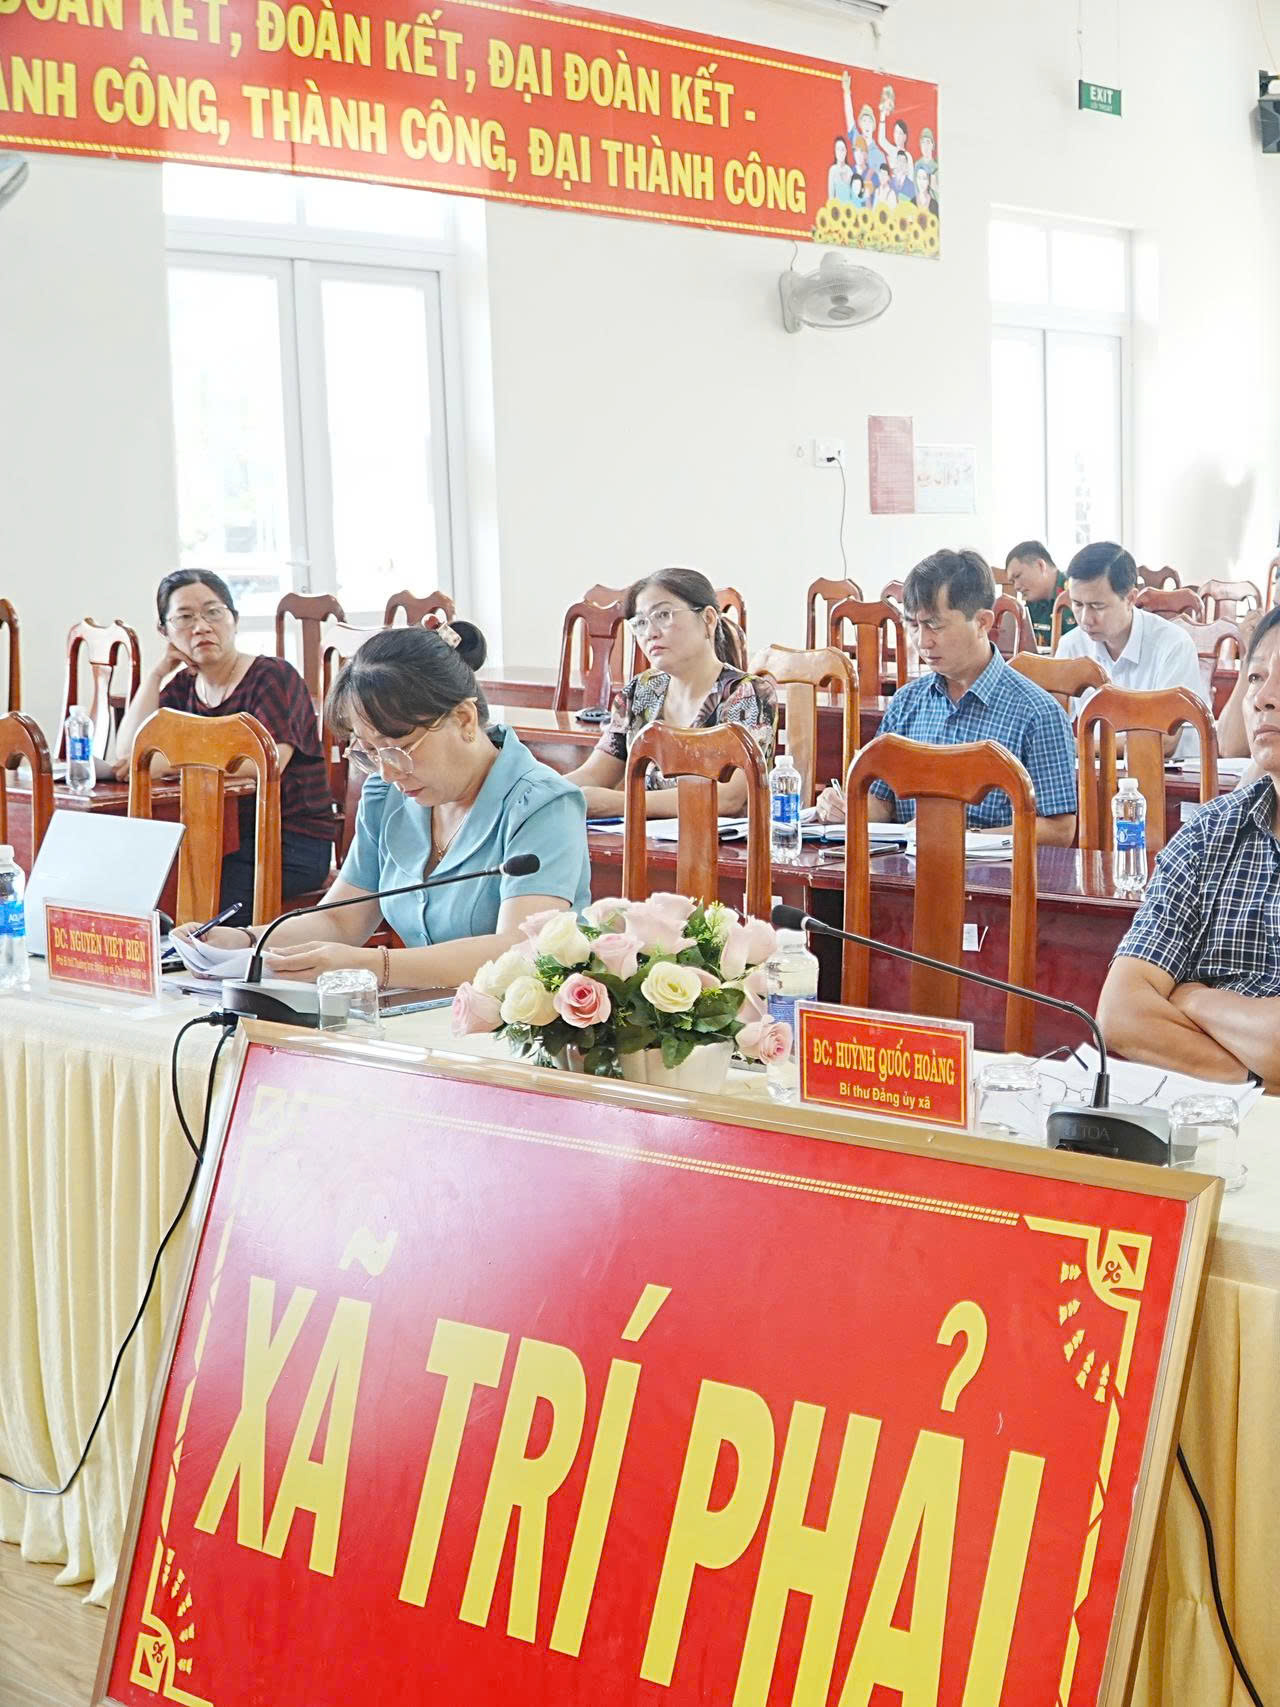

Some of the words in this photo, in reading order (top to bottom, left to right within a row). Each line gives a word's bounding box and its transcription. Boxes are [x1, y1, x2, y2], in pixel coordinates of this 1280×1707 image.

[256, 0, 371, 67] ĐOÀN
[385, 10, 476, 93] KẾT,
[488, 39, 553, 104] ĐẠI
[564, 49, 666, 120] ĐOÀN
[671, 63, 735, 128] KẾT
[1090, 86, 1113, 104] EXIT
[92, 56, 230, 146] CÔNG,
[242, 79, 388, 155] THÀNH
[401, 98, 517, 182] CÔNG,
[529, 127, 591, 191] ĐẠI
[601, 135, 714, 200] THÀNH
[723, 152, 807, 214] CÔNG
[813, 1038, 832, 1066] ĐC:
[835, 1037, 876, 1073] HUỲNH
[879, 1039, 911, 1081] QUỐC
[914, 1049, 955, 1085] HOÀNG
[839, 1081, 850, 1096] Bí
[853, 1084, 870, 1099] thư
[872, 1087, 899, 1107] Đảng
[903, 1091, 915, 1109] ủy
[918, 1095, 931, 1109] xã
[194, 1226, 396, 1577] XÃ
[397, 1284, 671, 1658] TRÍ
[639, 1299, 1044, 1707] PHẢI
